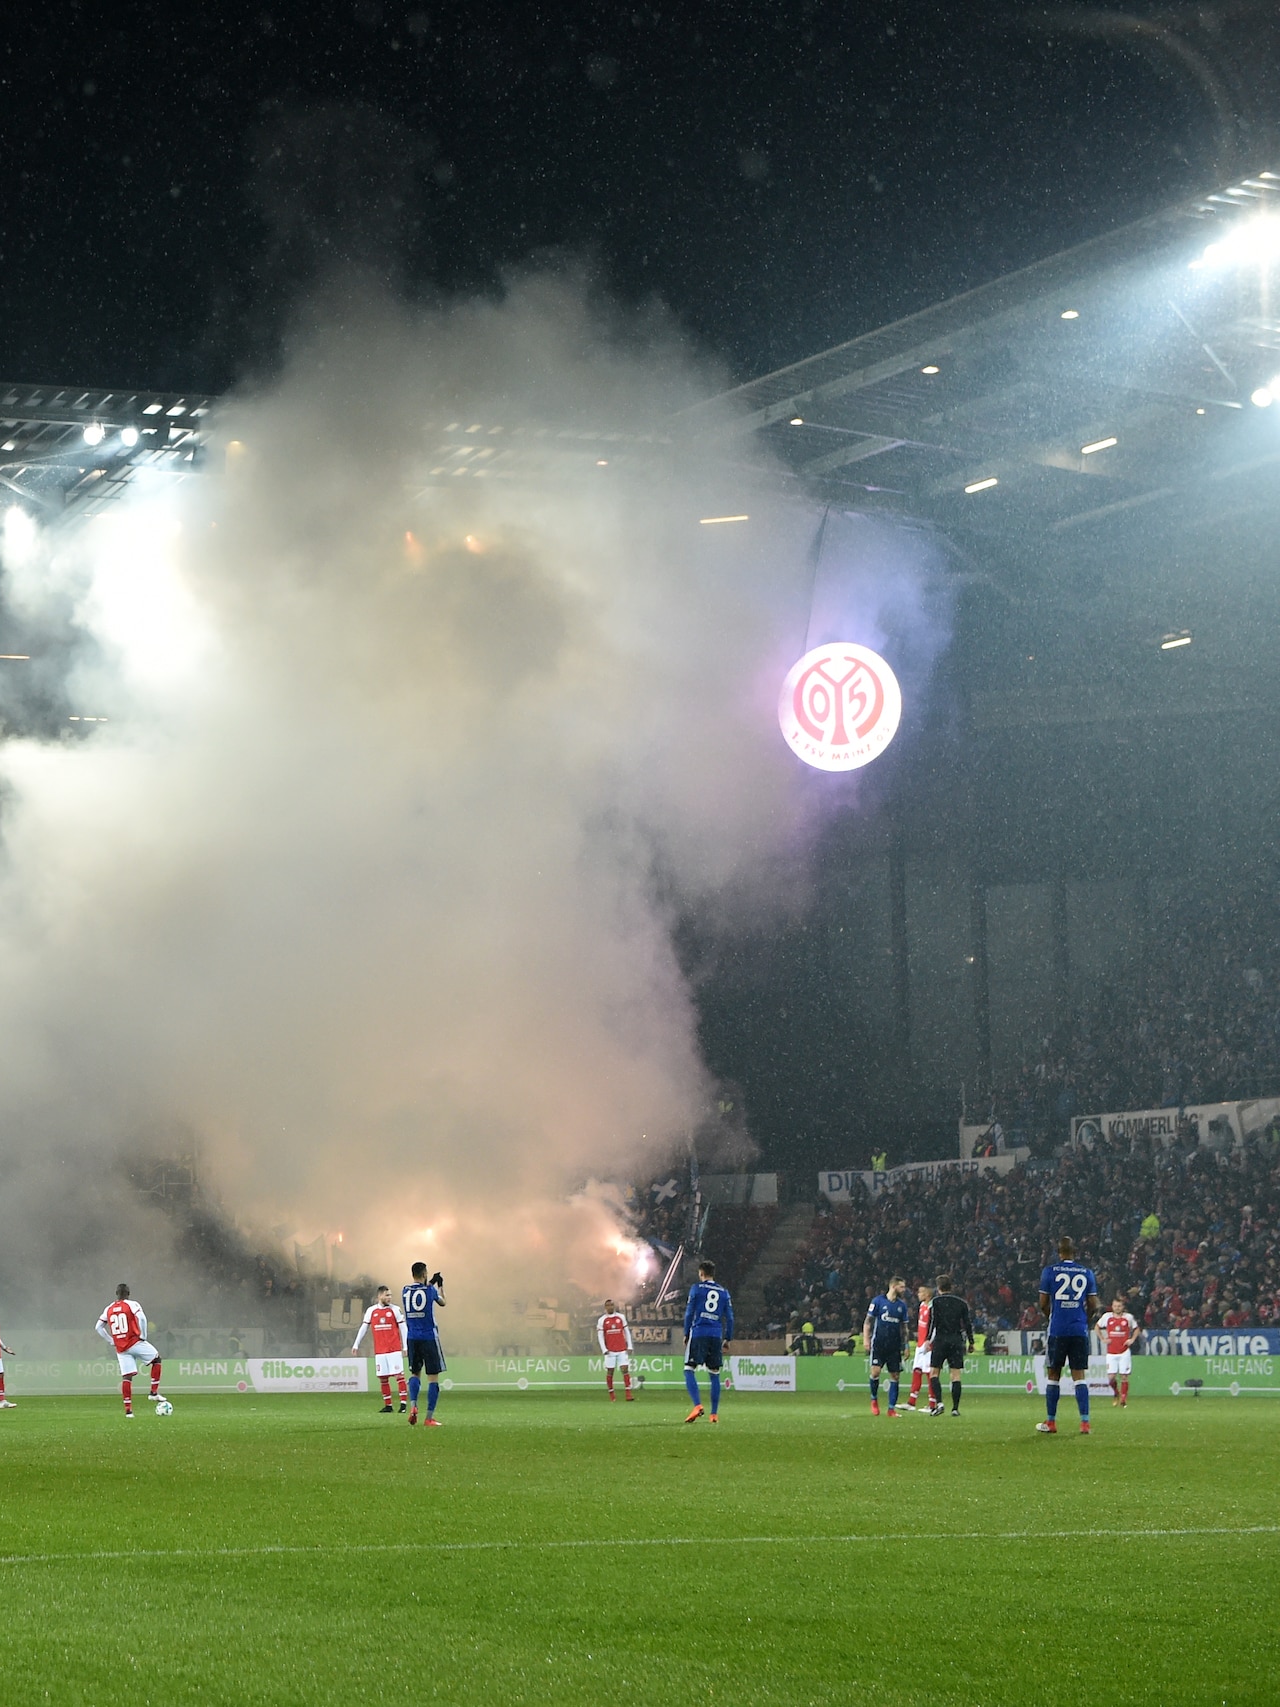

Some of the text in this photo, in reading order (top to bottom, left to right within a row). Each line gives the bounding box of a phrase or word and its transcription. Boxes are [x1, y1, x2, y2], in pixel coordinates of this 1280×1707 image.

[1109, 1114, 1198, 1137] KÖMMERLIG
[1055, 1273, 1087, 1300] 29
[403, 1290, 427, 1312] 10
[705, 1290, 719, 1312] 8
[110, 1313, 128, 1335] 20
[179, 1362, 228, 1376] HAHN
[261, 1360, 359, 1378] flibco.com
[486, 1359, 570, 1372] THALFANG
[738, 1358, 790, 1376] flibco.com
[989, 1359, 1021, 1374] HAHN
[1204, 1359, 1273, 1375] THALFANG
